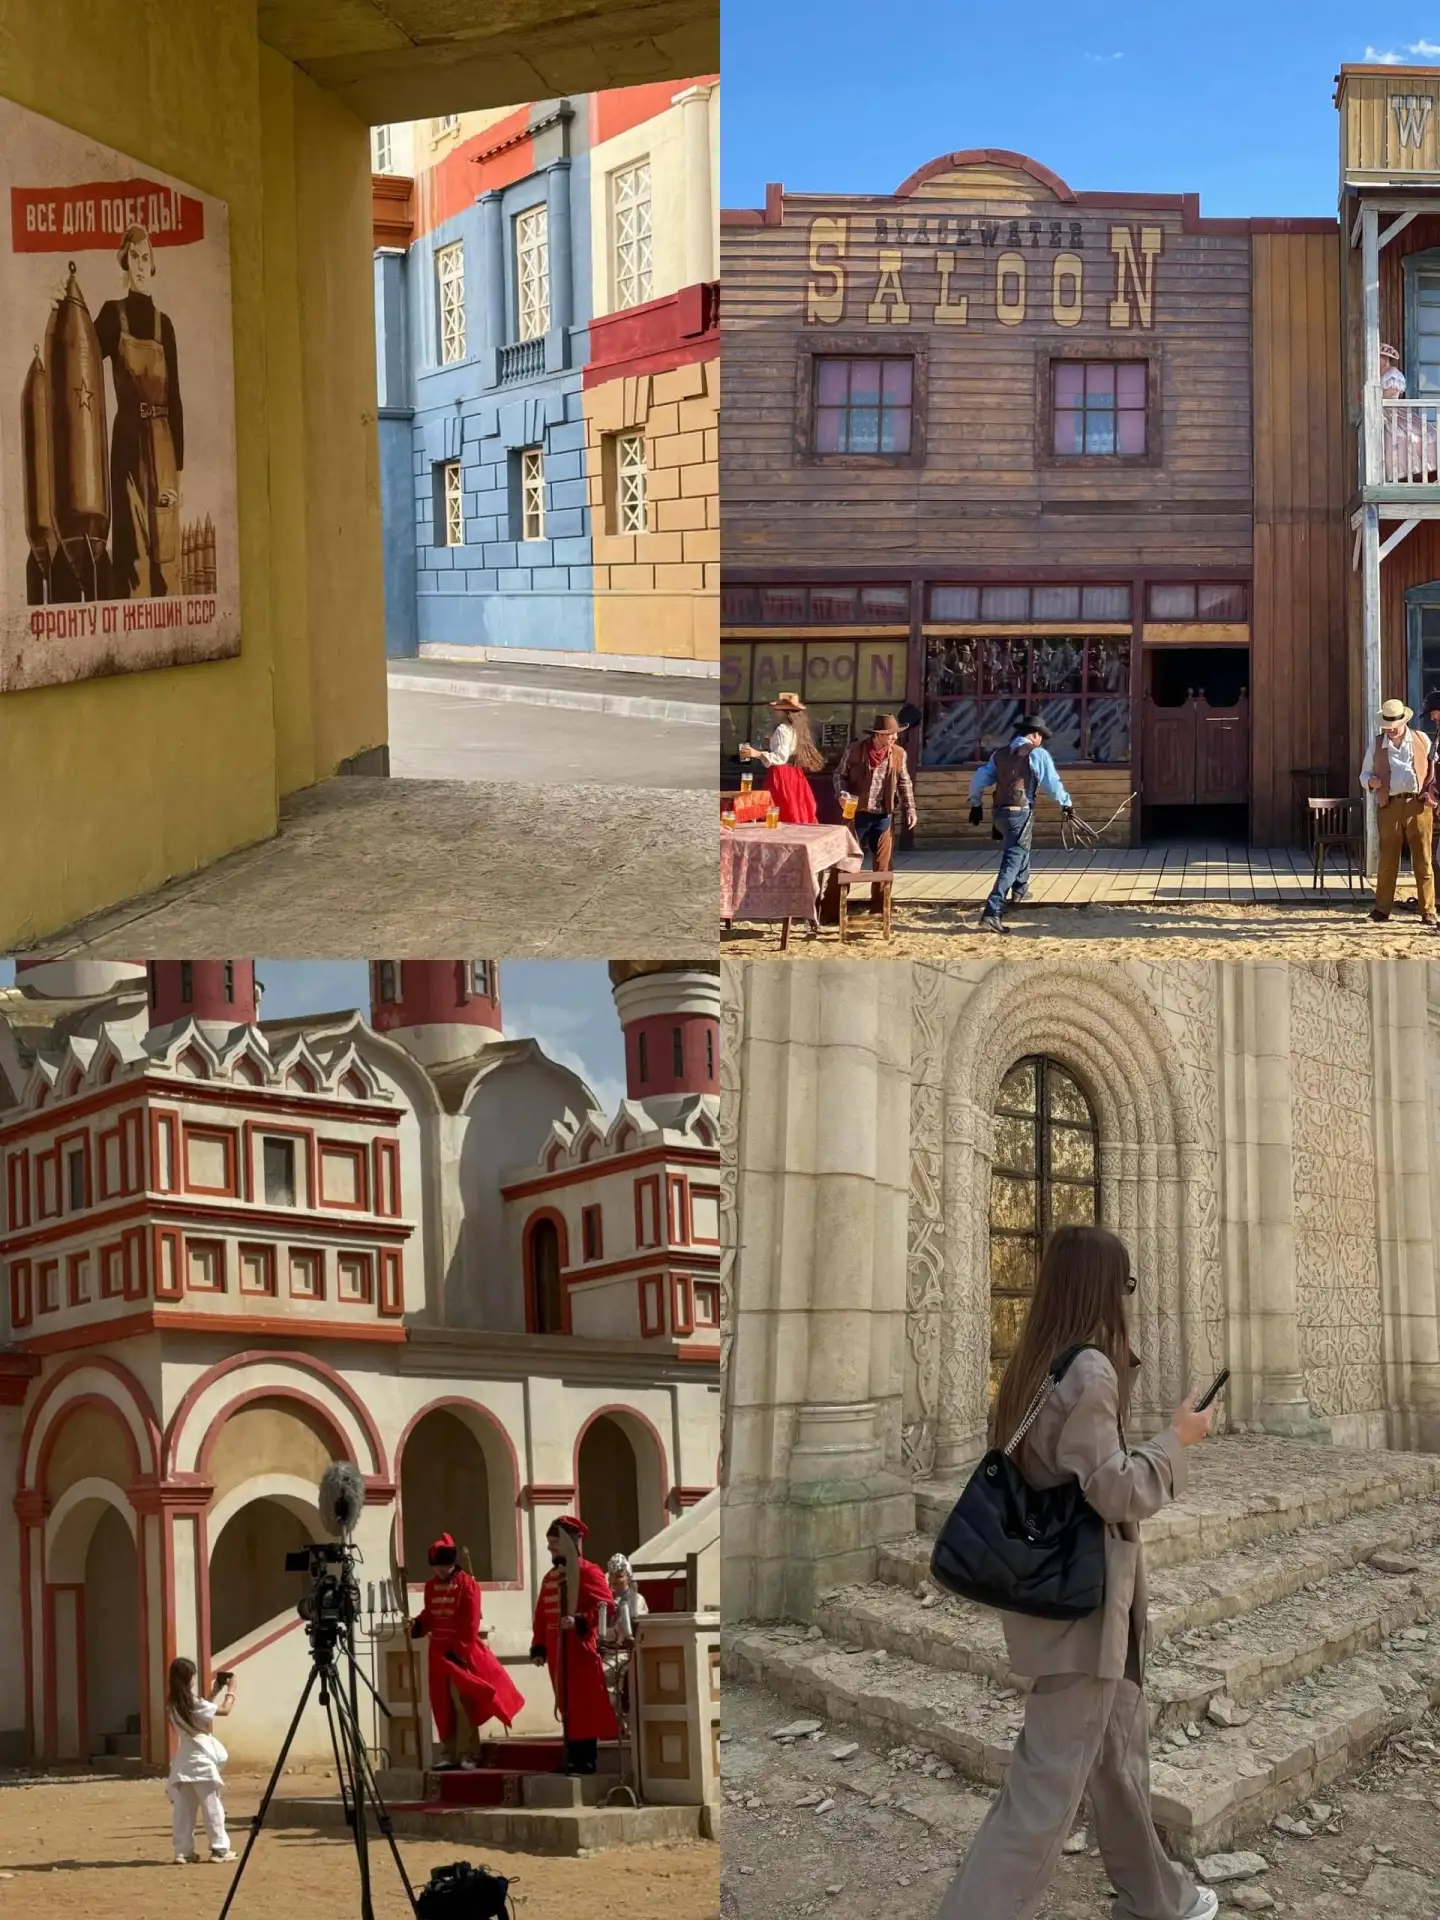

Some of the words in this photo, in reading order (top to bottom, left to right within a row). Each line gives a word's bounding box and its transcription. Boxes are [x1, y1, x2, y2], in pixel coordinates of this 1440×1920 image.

[1391, 94, 1433, 149] W
[26, 202, 57, 232] ВСЕ
[62, 199, 96, 235] ДЛЯ
[101, 191, 184, 235] ПОБЕДЫ!
[804, 215, 1164, 331] SALOON
[30, 605, 97, 642] ФРОНТУ
[101, 606, 119, 634] ОТ
[123, 601, 183, 632] ЖЕНЩИН
[186, 599, 216, 625] СССР
[720, 653, 894, 696] SALOON
